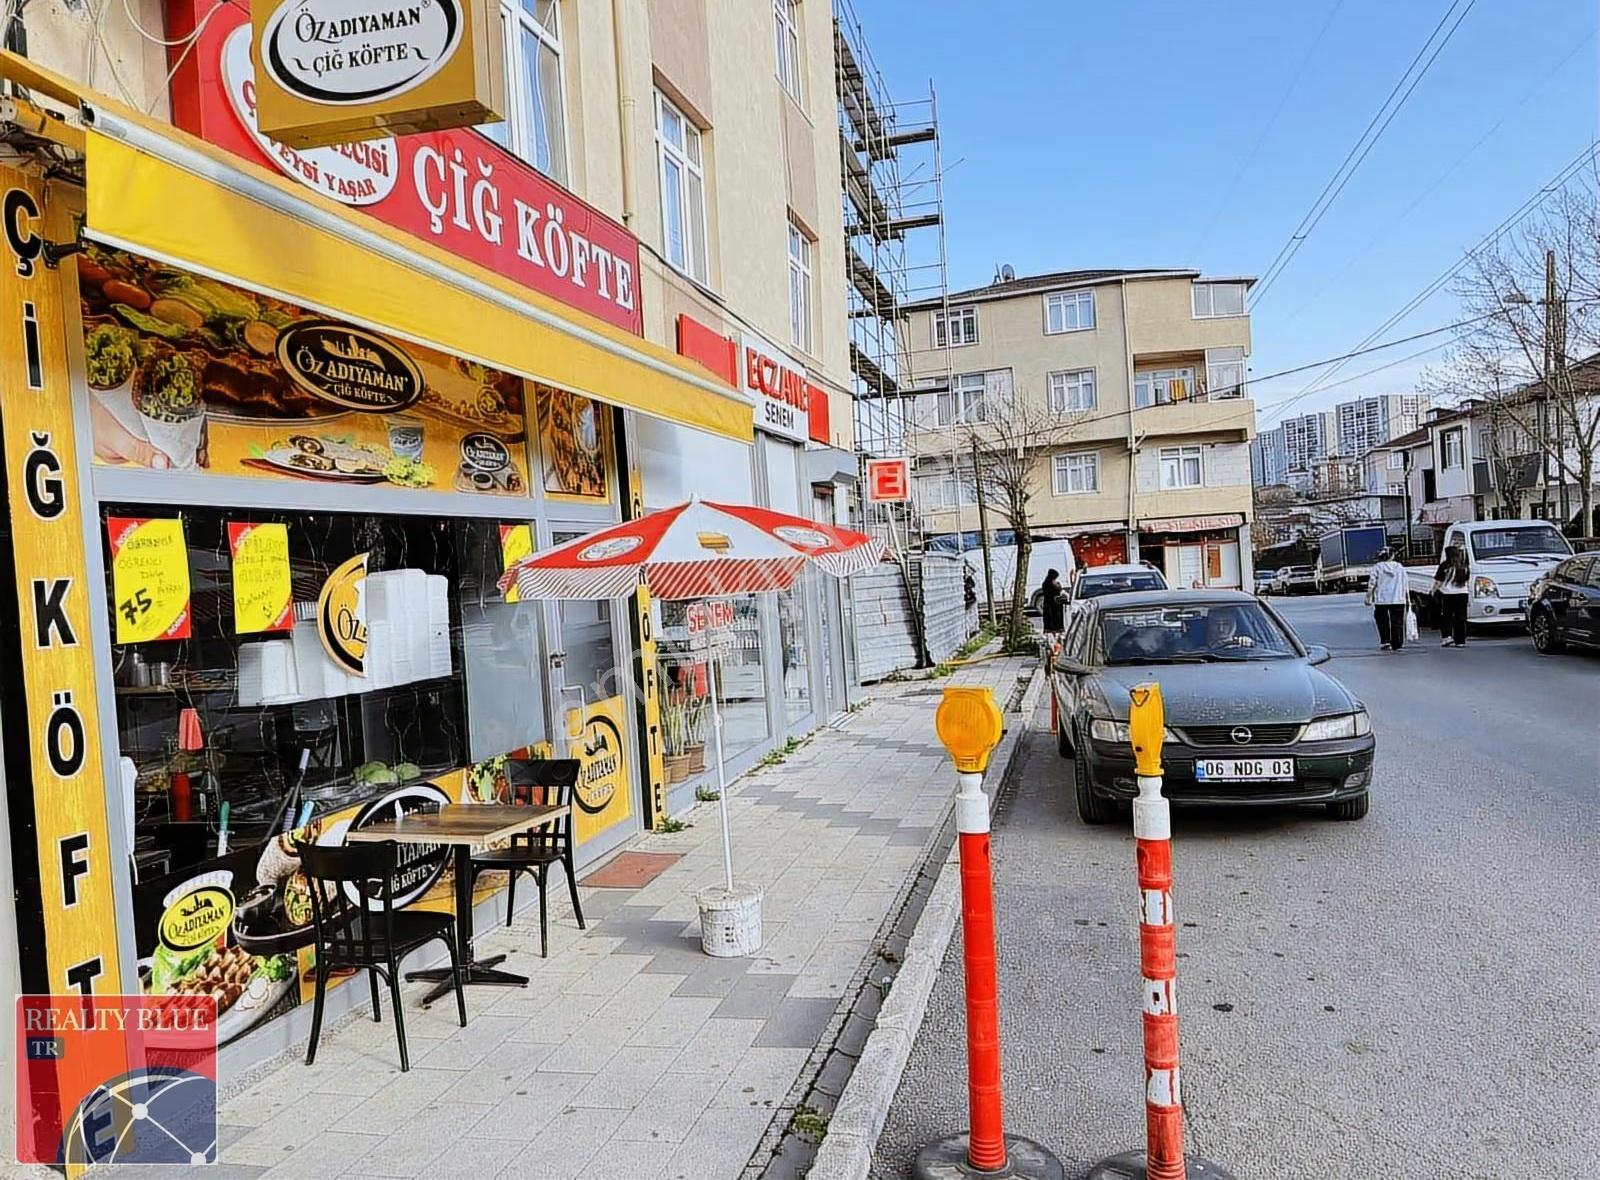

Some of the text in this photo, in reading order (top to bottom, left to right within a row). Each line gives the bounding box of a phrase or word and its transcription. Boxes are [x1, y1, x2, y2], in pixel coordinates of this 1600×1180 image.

[313, 42, 409, 78] ÇİĞ KÖFTE
[323, 172, 377, 202] YAŞAR
[413, 145, 634, 311] ÇİĞ KÖFTE
[765, 402, 795, 430] SENEM
[1205, 761, 1292, 776] 06 NDG 03
